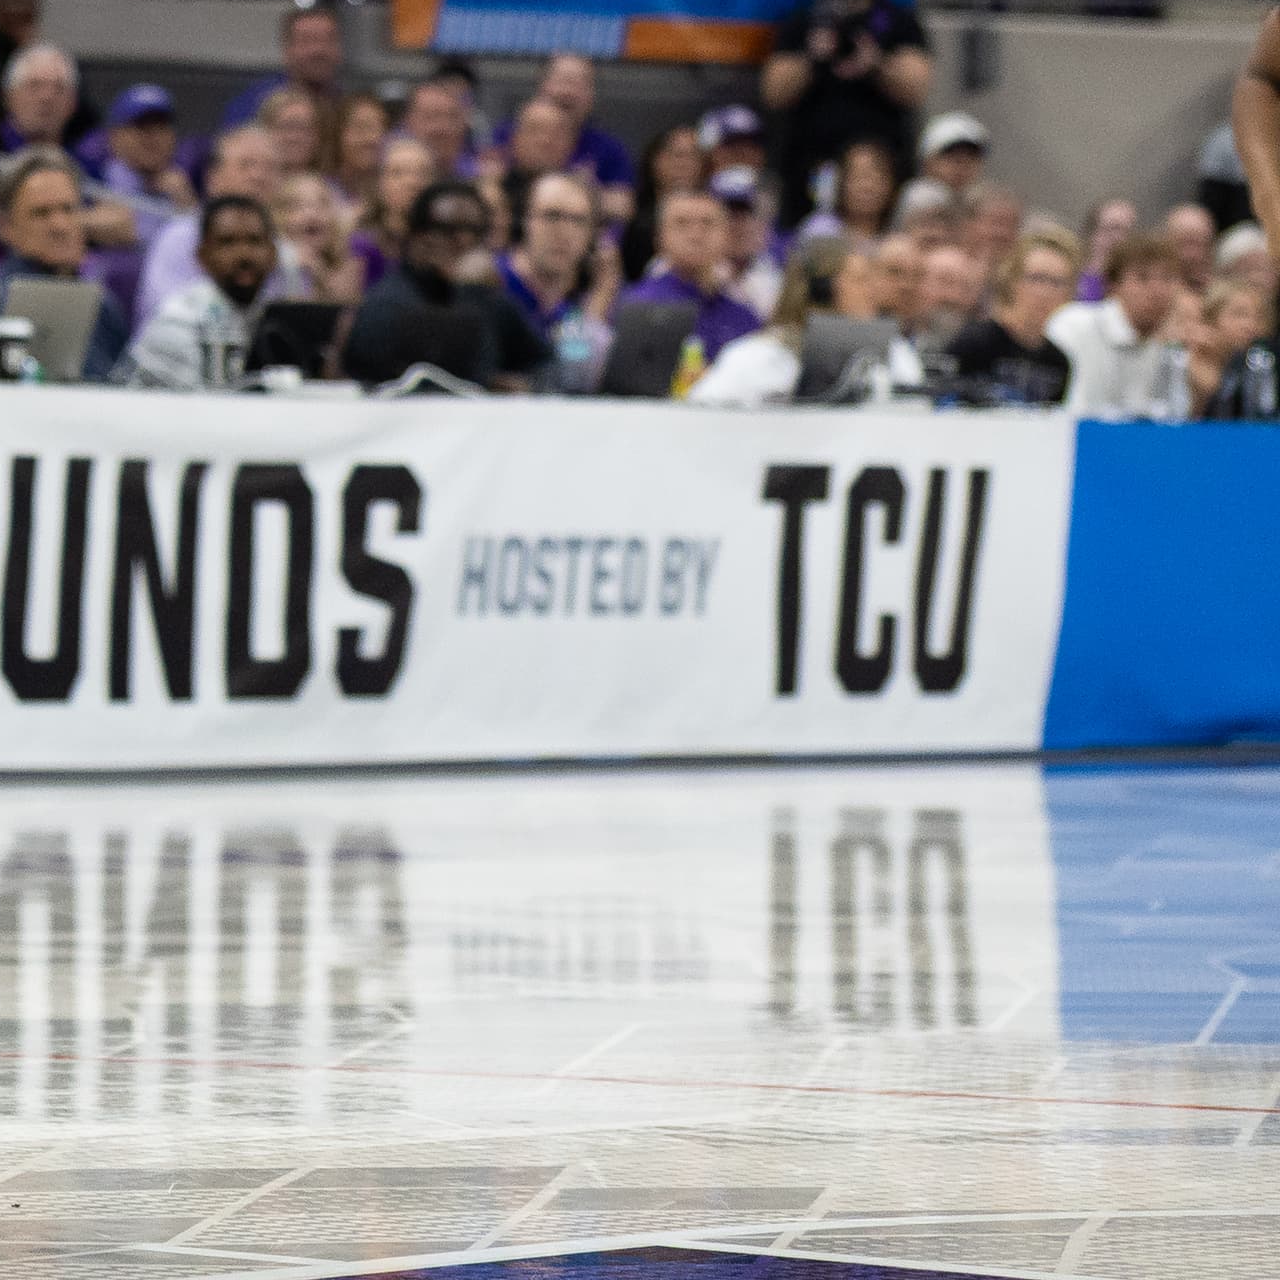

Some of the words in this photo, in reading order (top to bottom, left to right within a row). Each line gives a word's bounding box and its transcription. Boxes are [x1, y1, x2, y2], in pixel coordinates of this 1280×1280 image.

[457, 533, 649, 618] HOSTED
[654, 537, 721, 619] BY
[761, 463, 993, 697] TCU
